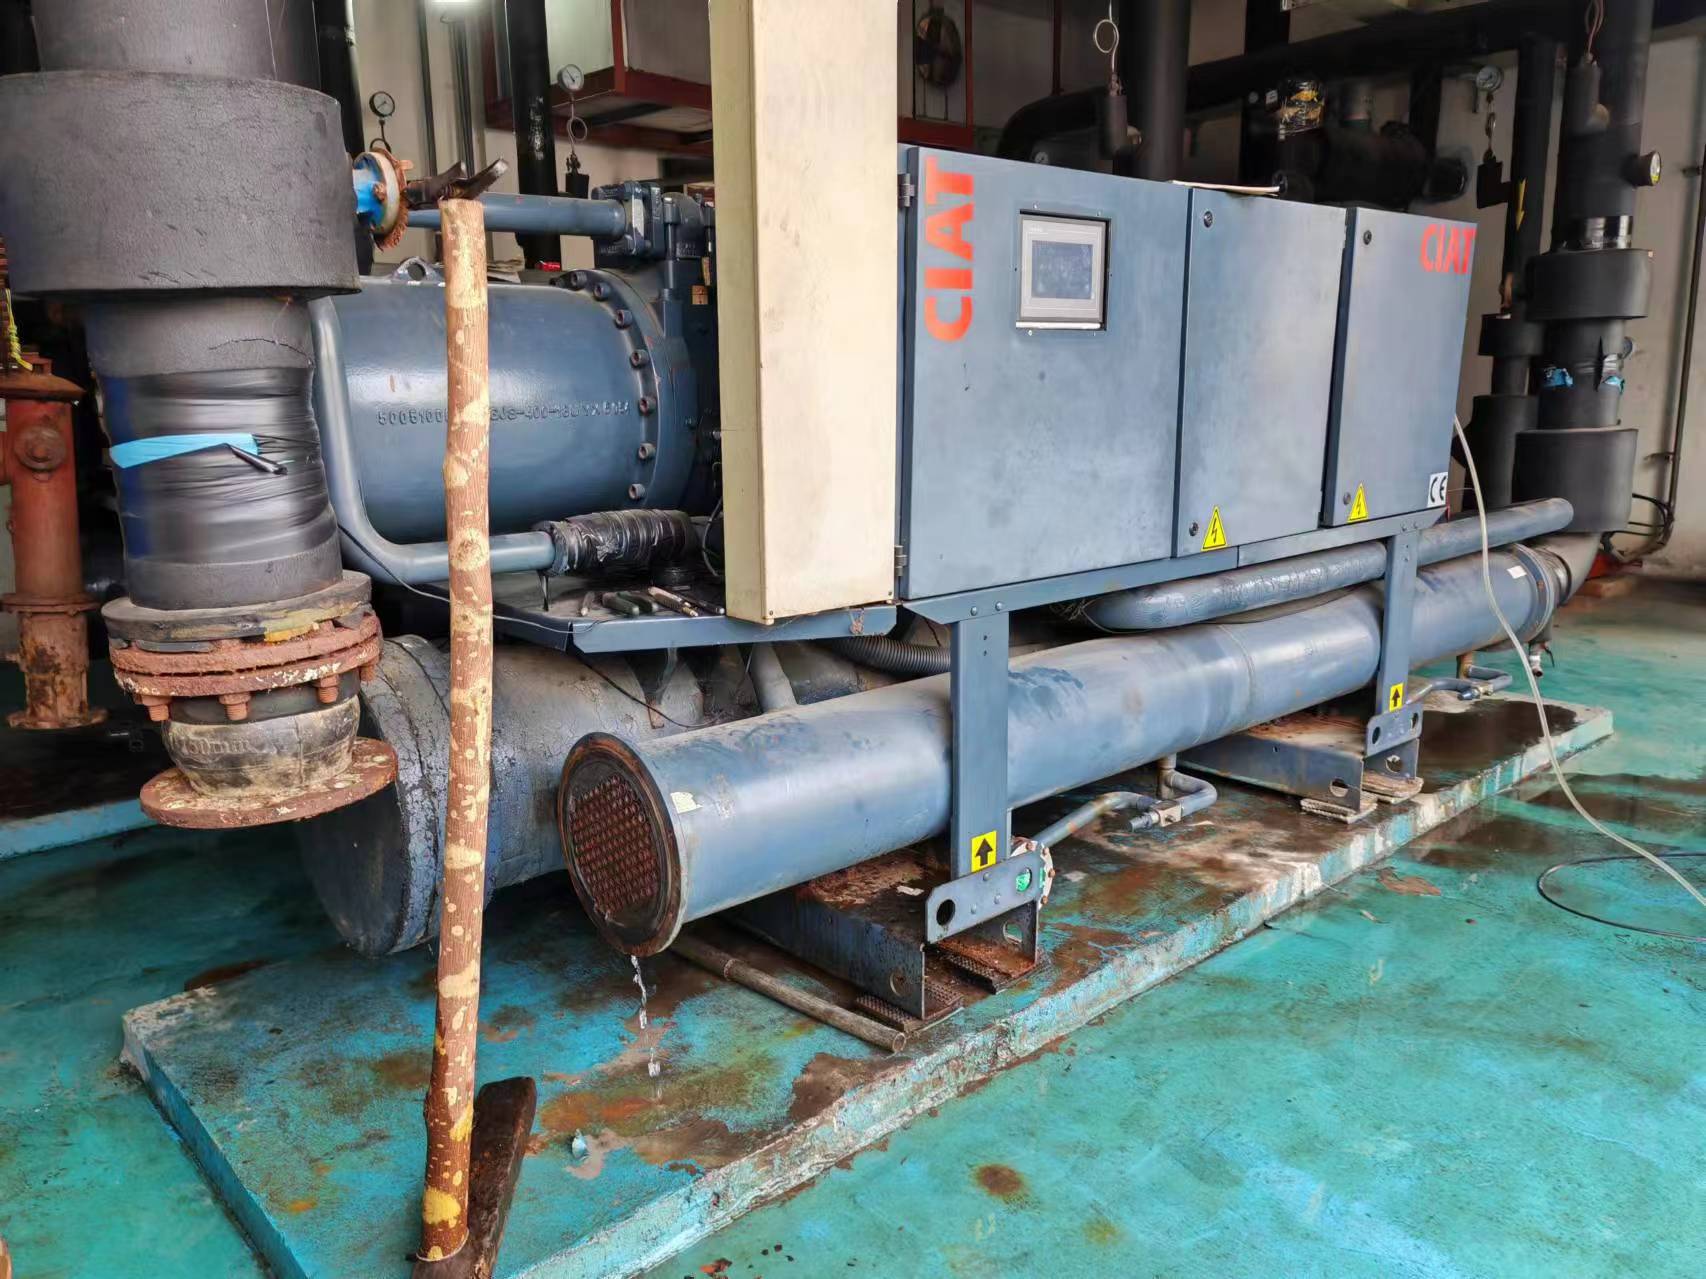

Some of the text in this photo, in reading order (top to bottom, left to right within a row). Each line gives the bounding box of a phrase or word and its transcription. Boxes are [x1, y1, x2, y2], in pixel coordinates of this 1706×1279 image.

[924, 156, 974, 342] CIAT
[1420, 223, 1477, 274] CIAT
[1430, 475, 1447, 503] CE
